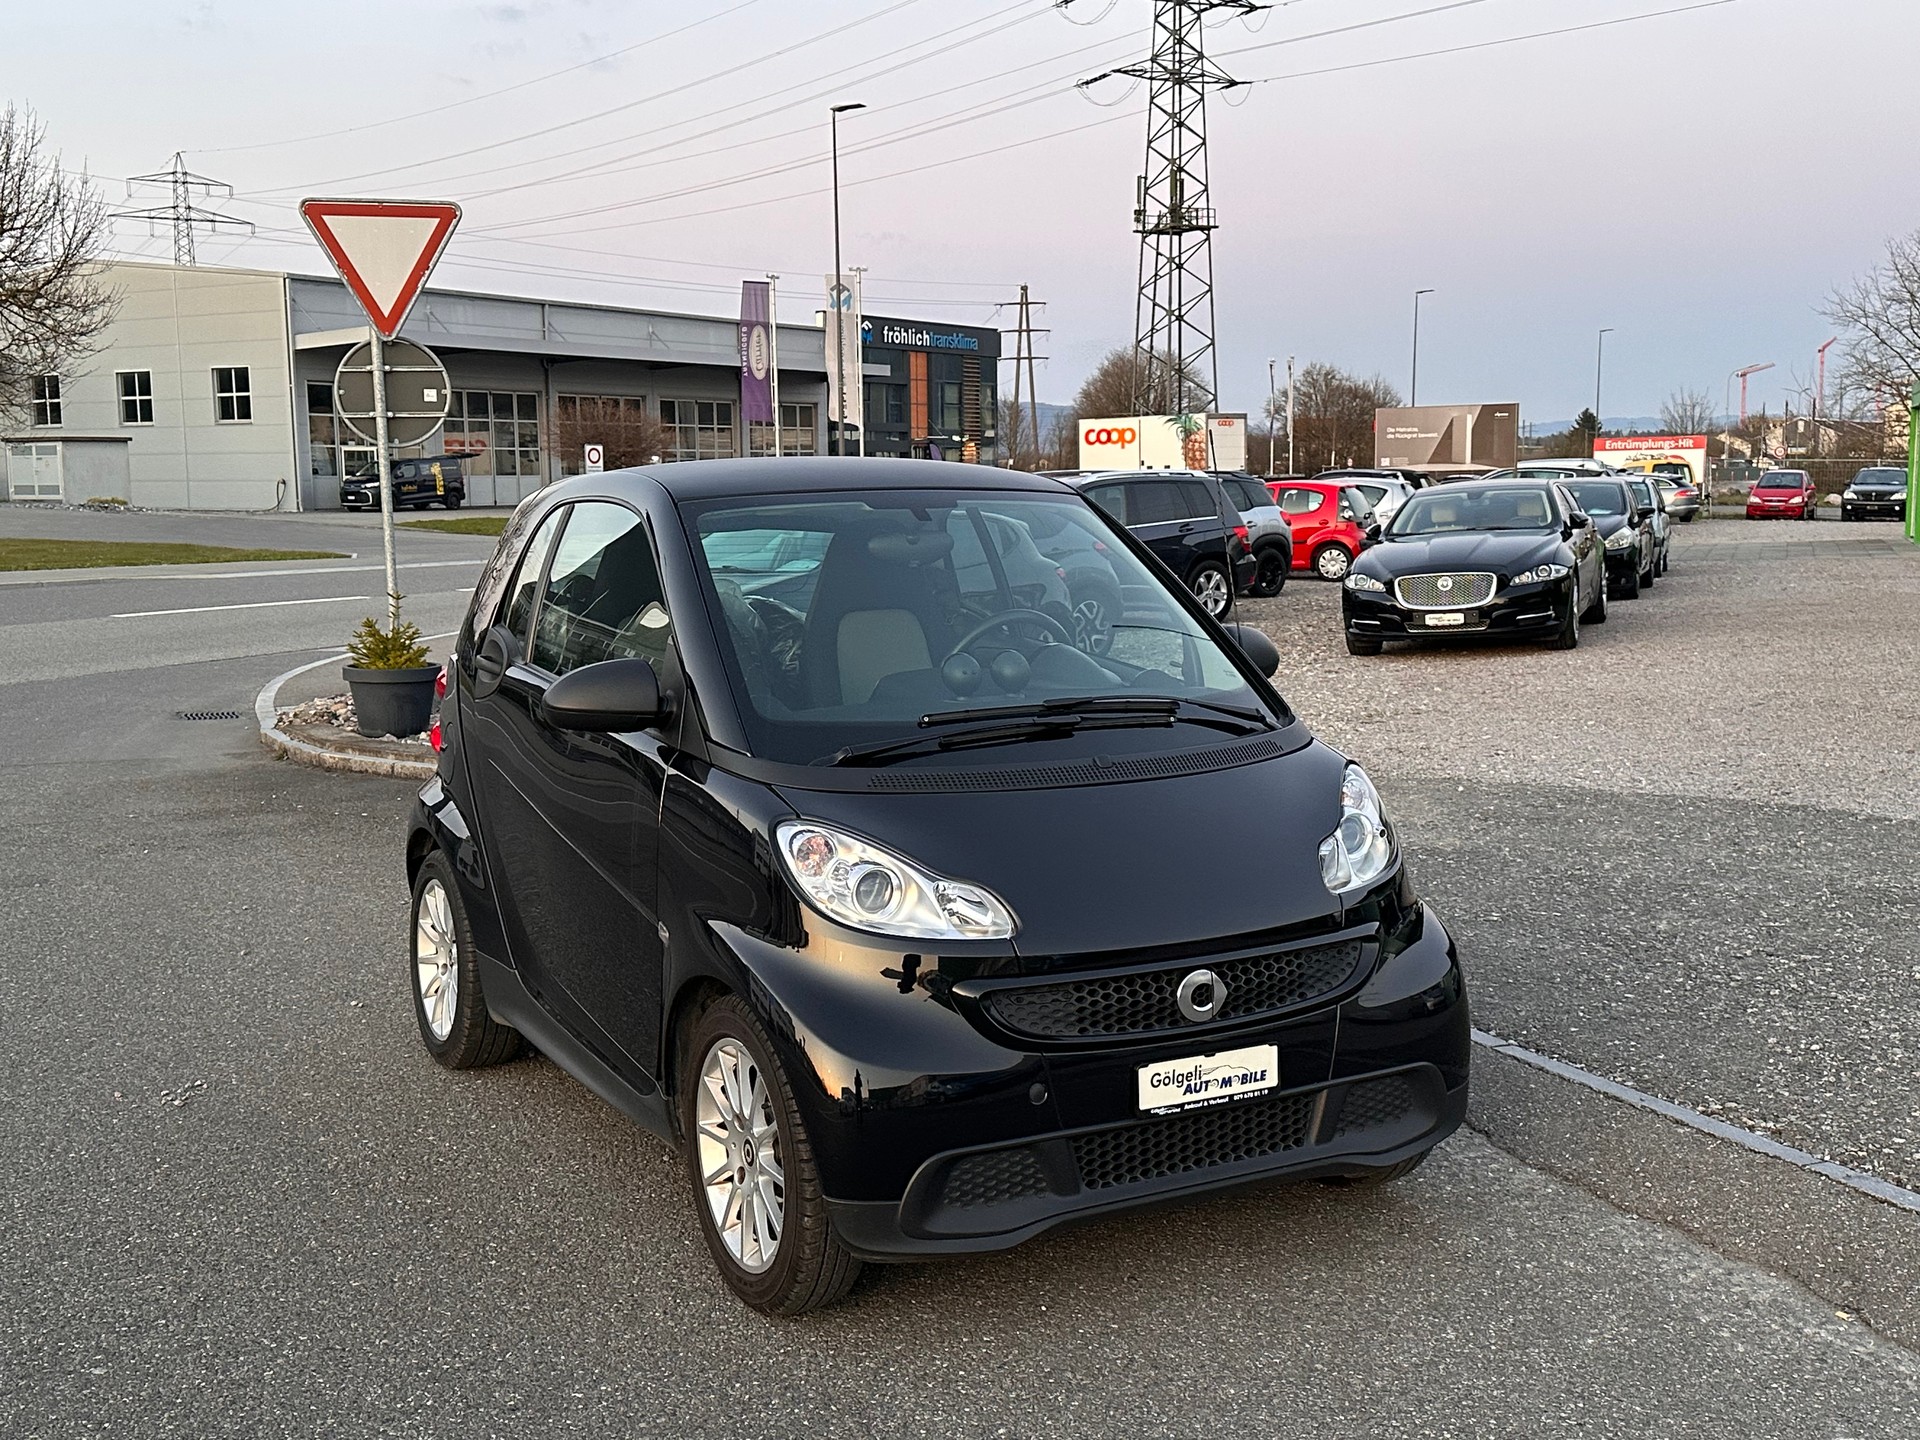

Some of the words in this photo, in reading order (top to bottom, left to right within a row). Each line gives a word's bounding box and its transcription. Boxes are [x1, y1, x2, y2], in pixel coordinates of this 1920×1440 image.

[1084, 428, 1136, 449] coop
[1605, 439, 1694, 450] Entrümplungs-Hit
[1151, 1064, 1202, 1088] Gölgeli
